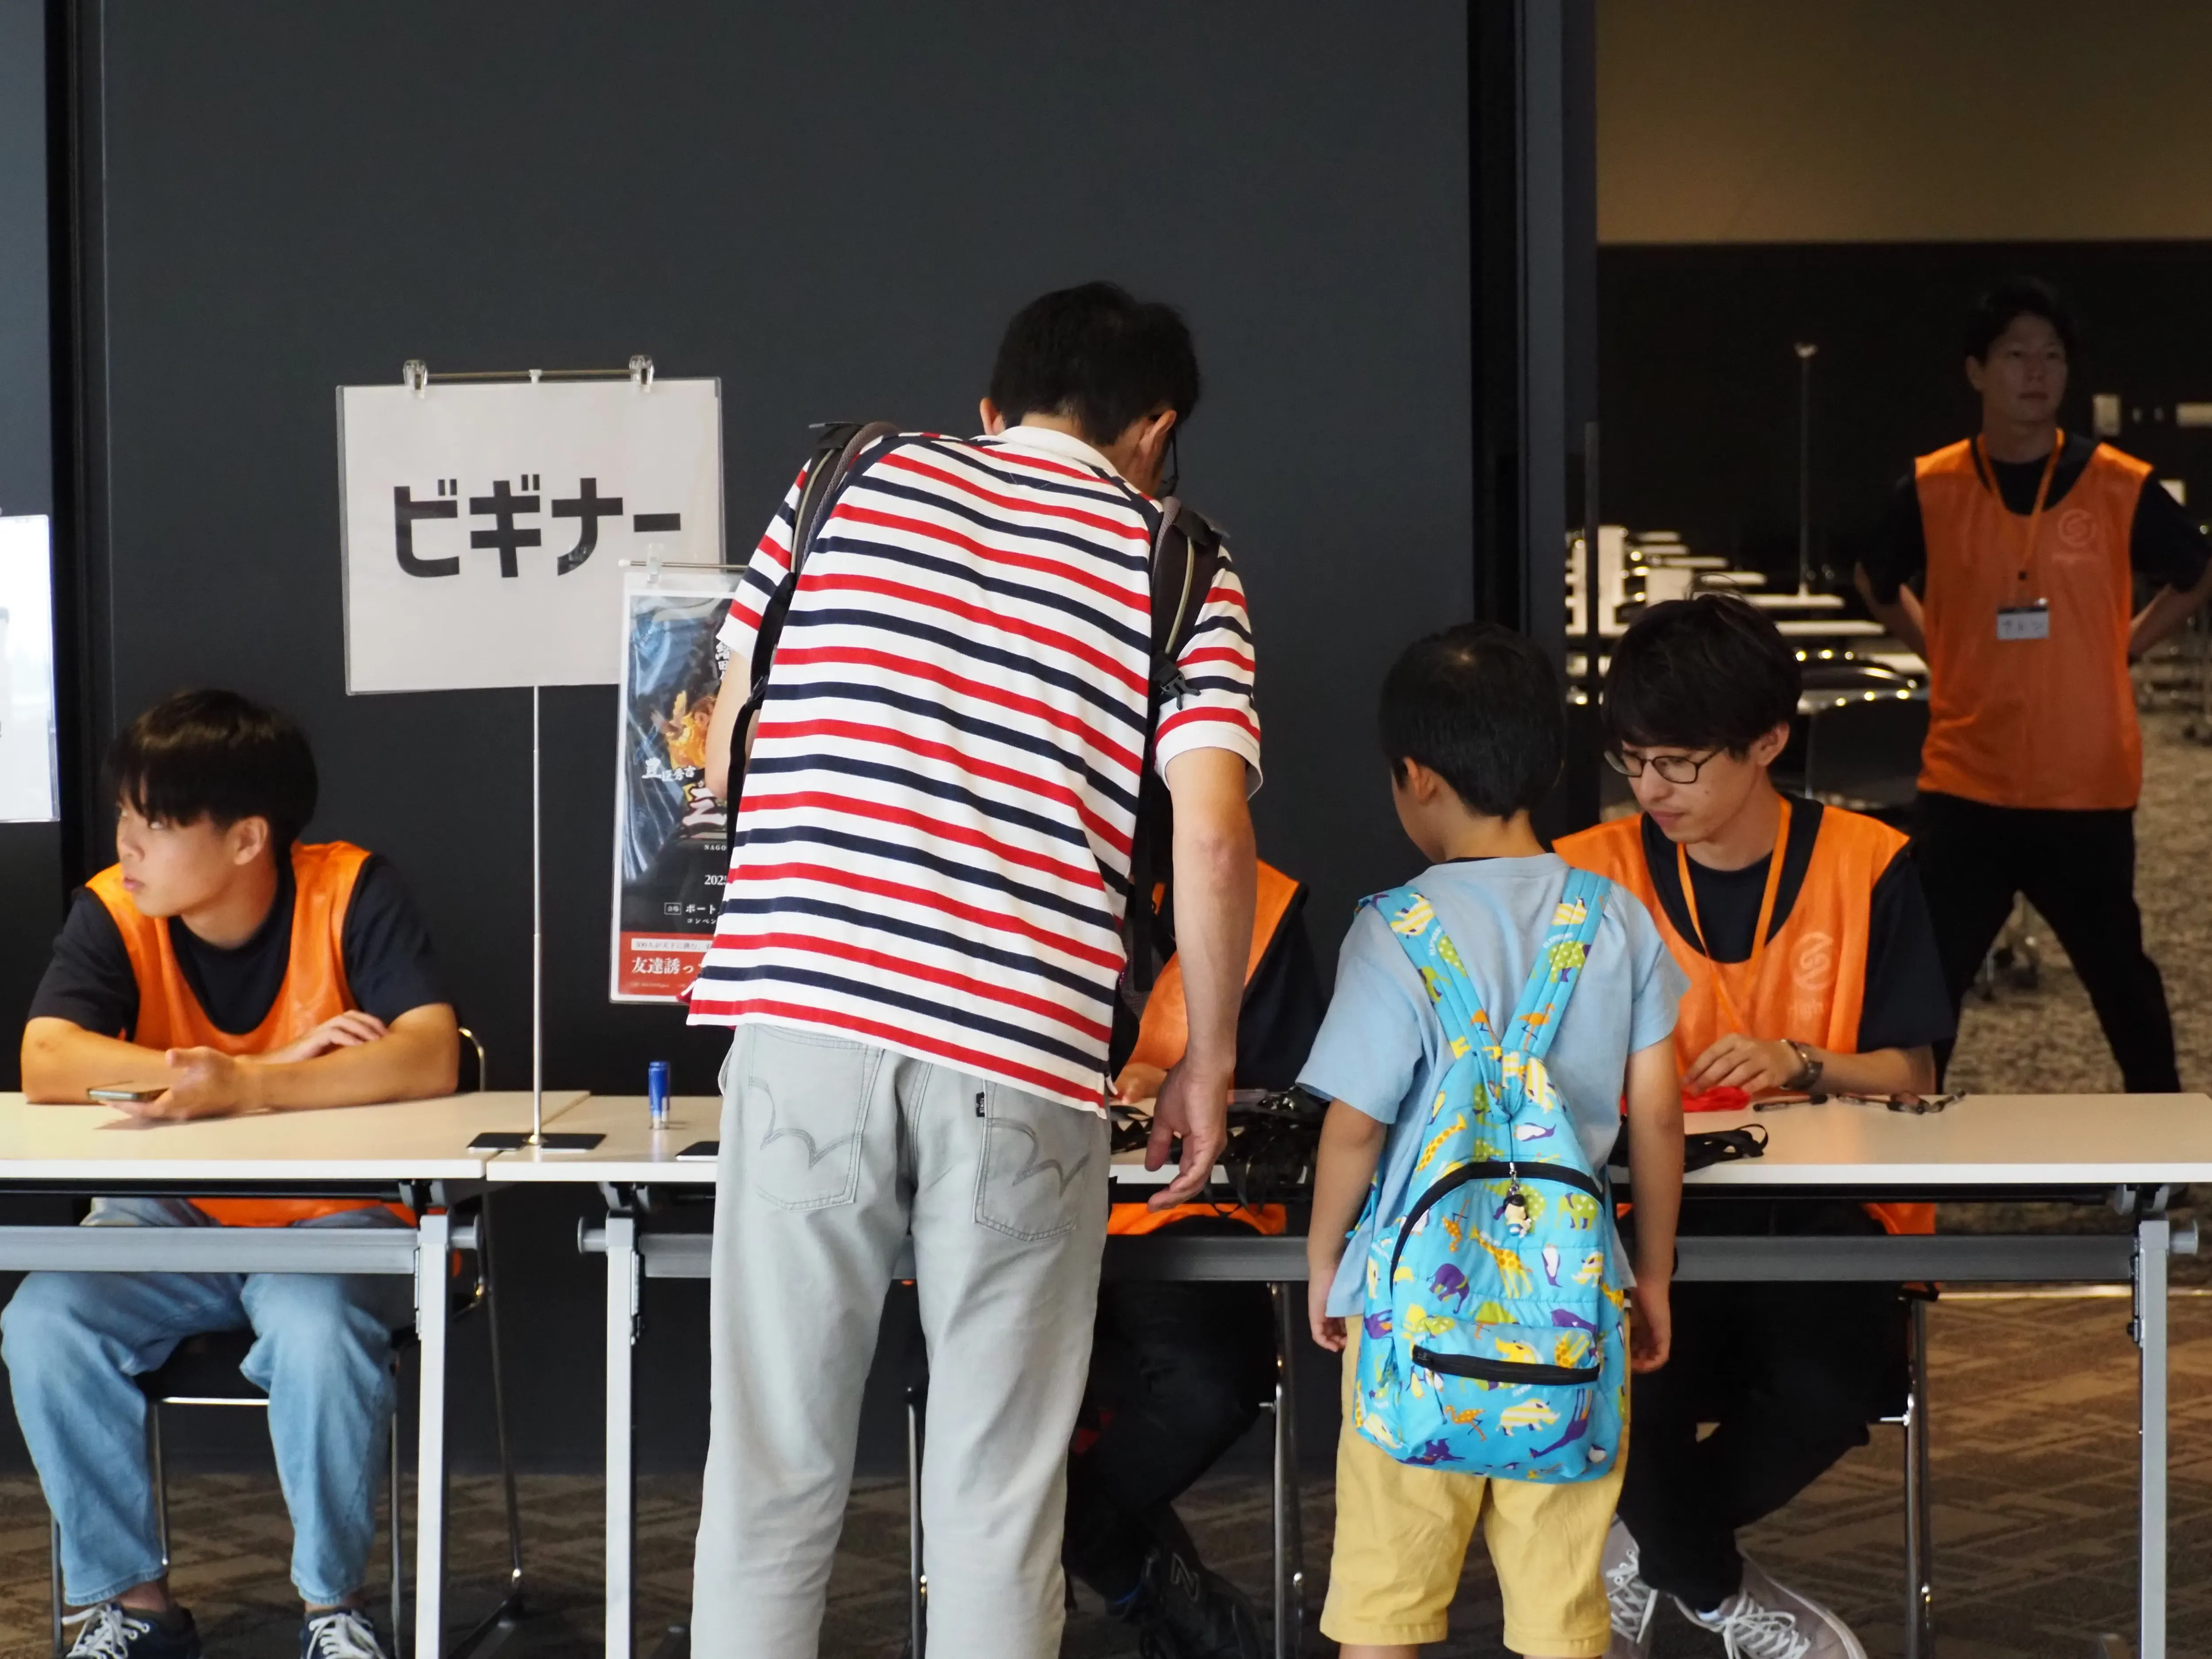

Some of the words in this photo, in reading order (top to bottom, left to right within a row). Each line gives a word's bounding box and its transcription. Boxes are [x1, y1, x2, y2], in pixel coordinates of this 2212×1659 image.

[394, 474, 681, 578] ビギナー
[641, 757, 696, 782] 豊臣秀吉
[631, 956, 703, 974] 友達誘っ
